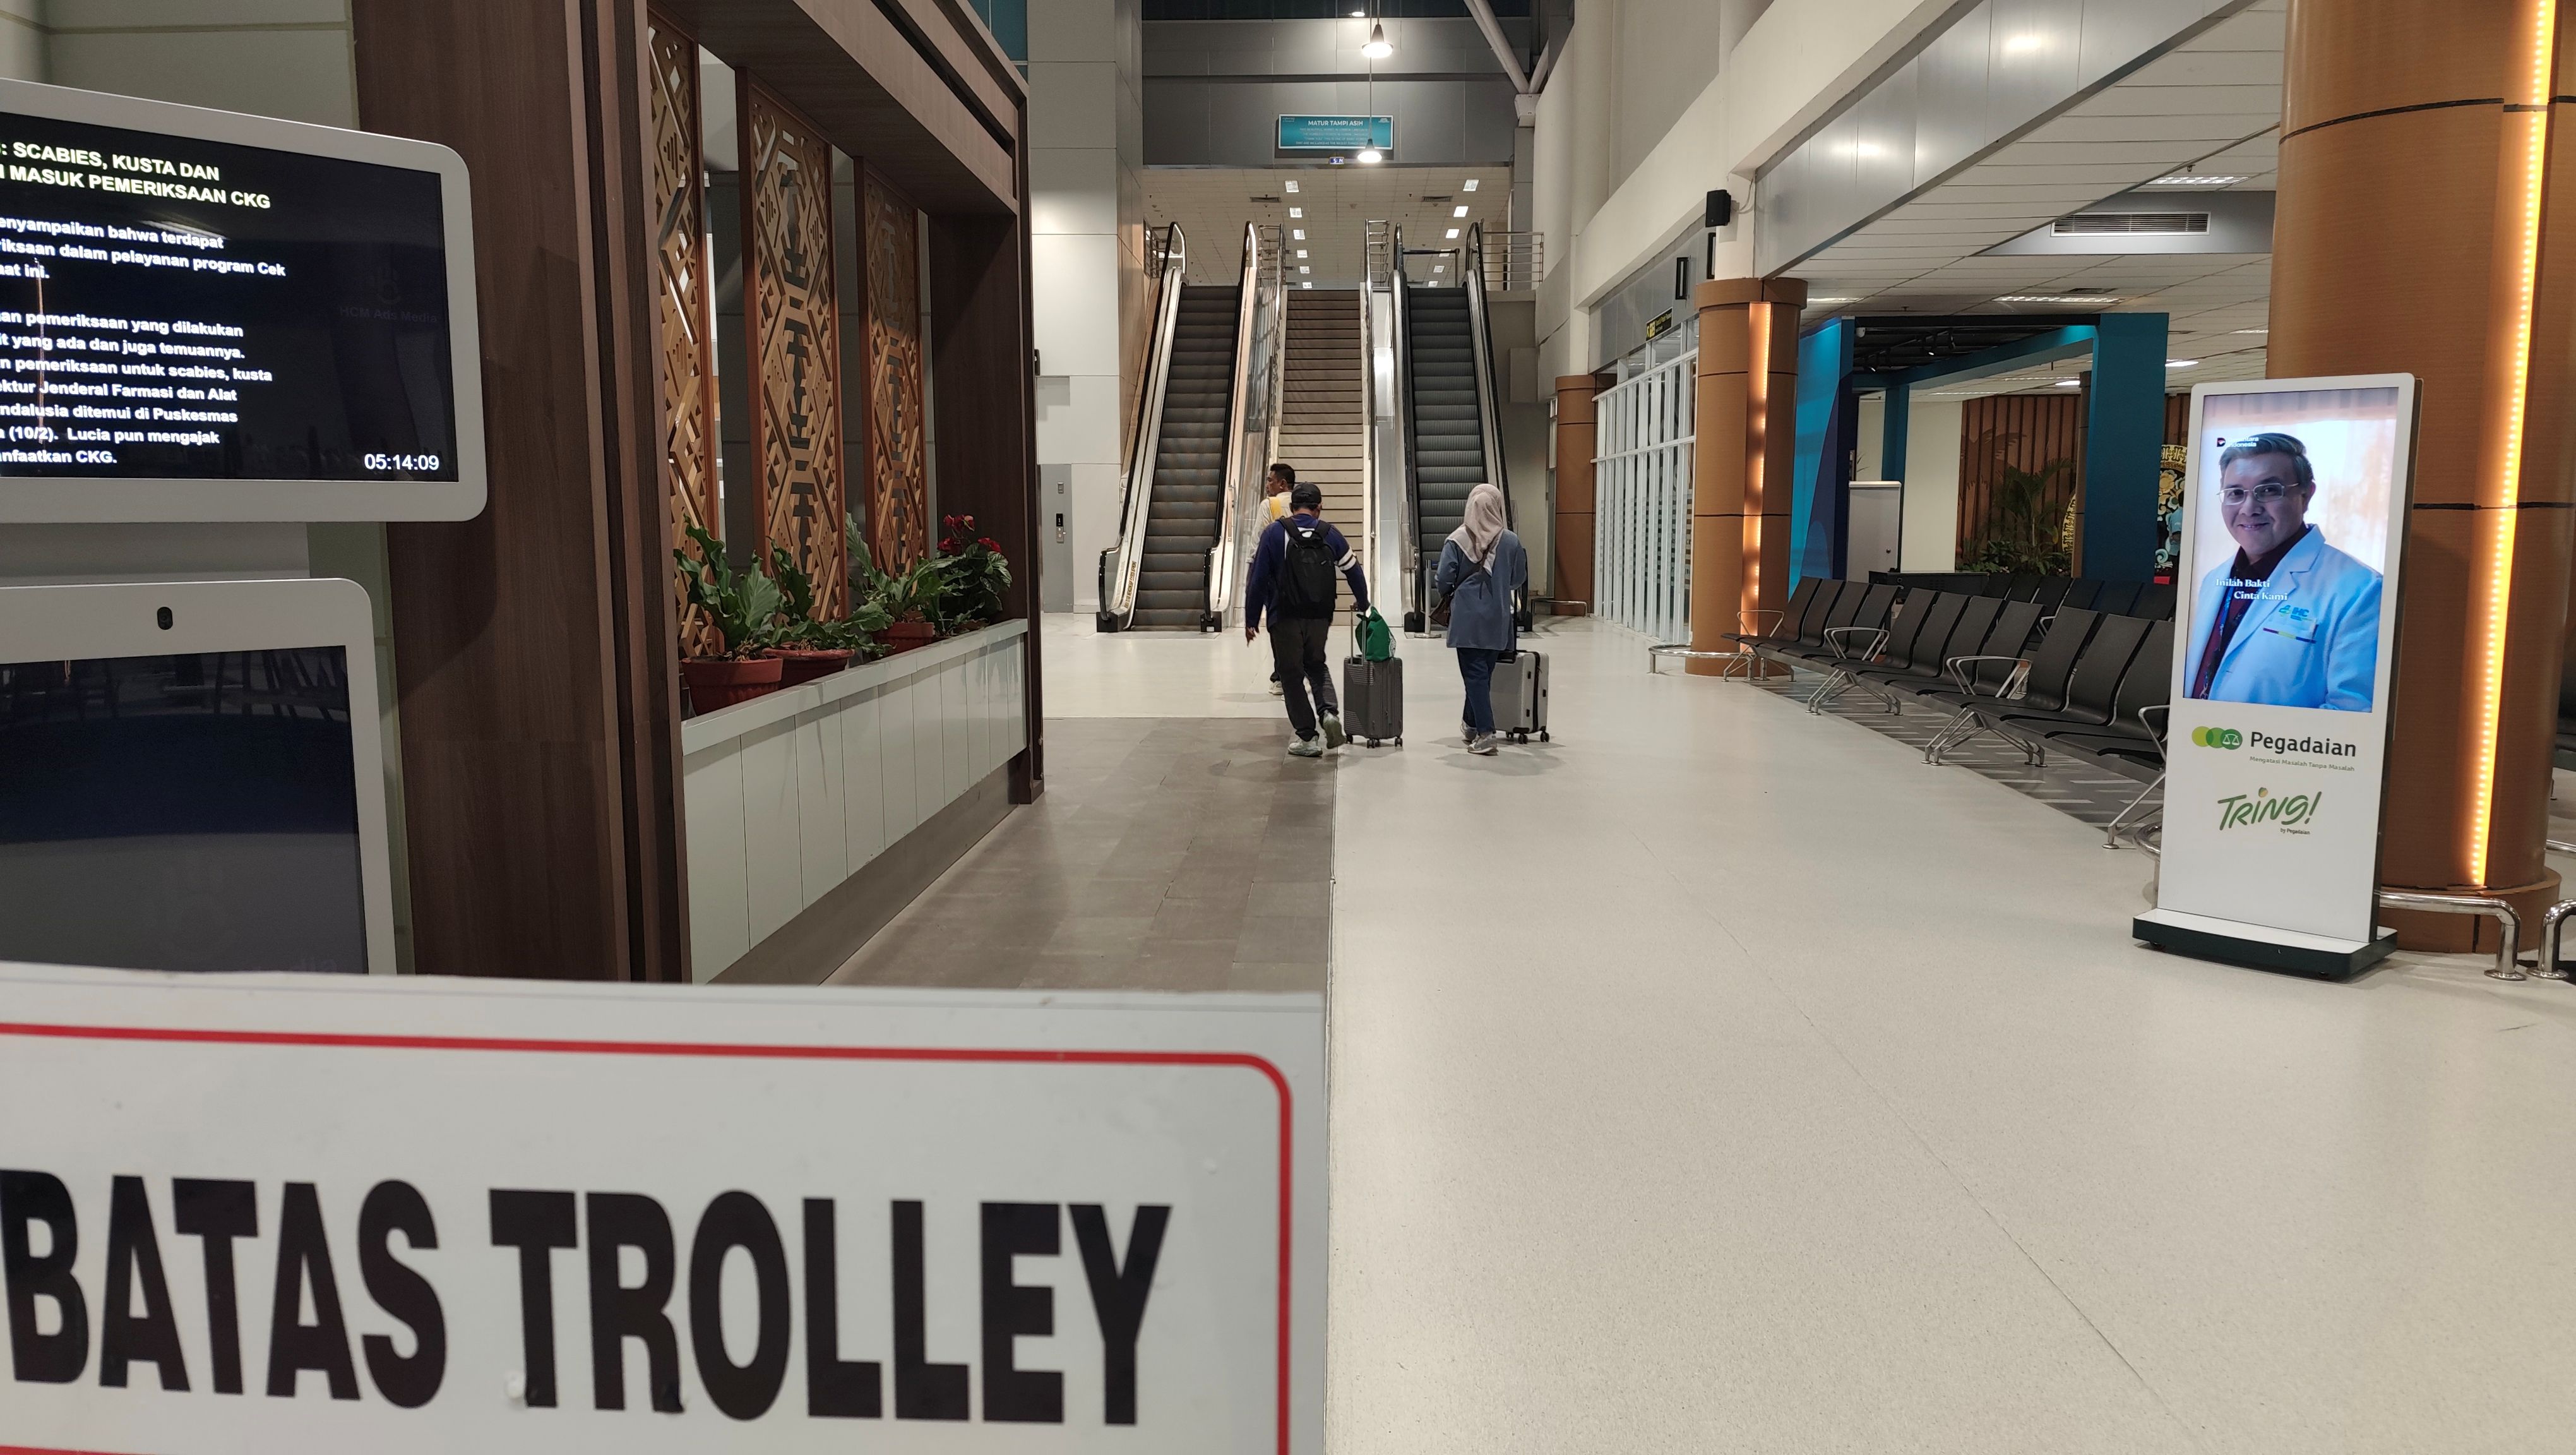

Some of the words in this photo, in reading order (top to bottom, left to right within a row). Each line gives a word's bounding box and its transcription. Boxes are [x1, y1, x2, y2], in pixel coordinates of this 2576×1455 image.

[13, 142, 108, 170] SCABIES,
[112, 154, 177, 176] KUSTA
[179, 162, 220, 181] DAN
[9, 165, 85, 188] MASUK
[88, 174, 227, 204] PEMERIKSAAN
[230, 191, 271, 209] CKG
[107, 225, 159, 242] bahwa
[161, 231, 224, 249] terdapat
[0, 238, 56, 256] iksaan
[59, 244, 108, 260] dalam
[111, 250, 189, 268] pelayanan
[193, 258, 254, 273] program
[257, 261, 286, 277] Cek
[24, 263, 50, 278] ini.
[26, 313, 128, 330] pemeriksaan
[131, 320, 169, 335] yang
[172, 321, 244, 337] dilakukan
[11, 335, 53, 350] yang
[56, 337, 86, 350] ada
[89, 338, 119, 352] dan
[122, 340, 157, 356] juga
[159, 342, 245, 361] temuannya.
[15, 359, 118, 374] pemeriksaan
[121, 363, 165, 376] untuk
[168, 365, 230, 381] scabies,
[232, 367, 273, 381] kusta
[39, 381, 109, 396] Jenderal
[112, 383, 174, 398] Farmasi
[176, 387, 205, 400] dan
[207, 388, 237, 401] Alat
[73, 405, 131, 419] ditemui
[134, 407, 150, 420] di
[153, 407, 238, 422] Puskesmas
[9, 426, 59, 442] (10/2).
[67, 427, 110, 441] Lucia
[114, 431, 145, 444] pun
[147, 431, 220, 446] mengajak
[0, 450, 72, 462] nfaatkan
[75, 450, 117, 464] CKG.
[364, 453, 439, 470] 05:14:09
[2215, 578, 2243, 587] Inilah
[2245, 578, 2270, 588] Bakti
[2234, 591, 2260, 600] Cinta
[2262, 592, 2288, 601] Kami
[2250, 731, 2356, 757] Pegadaian
[0, 1169, 447, 1409] BATAS
[487, 1189, 1172, 1427] TROLLEY
